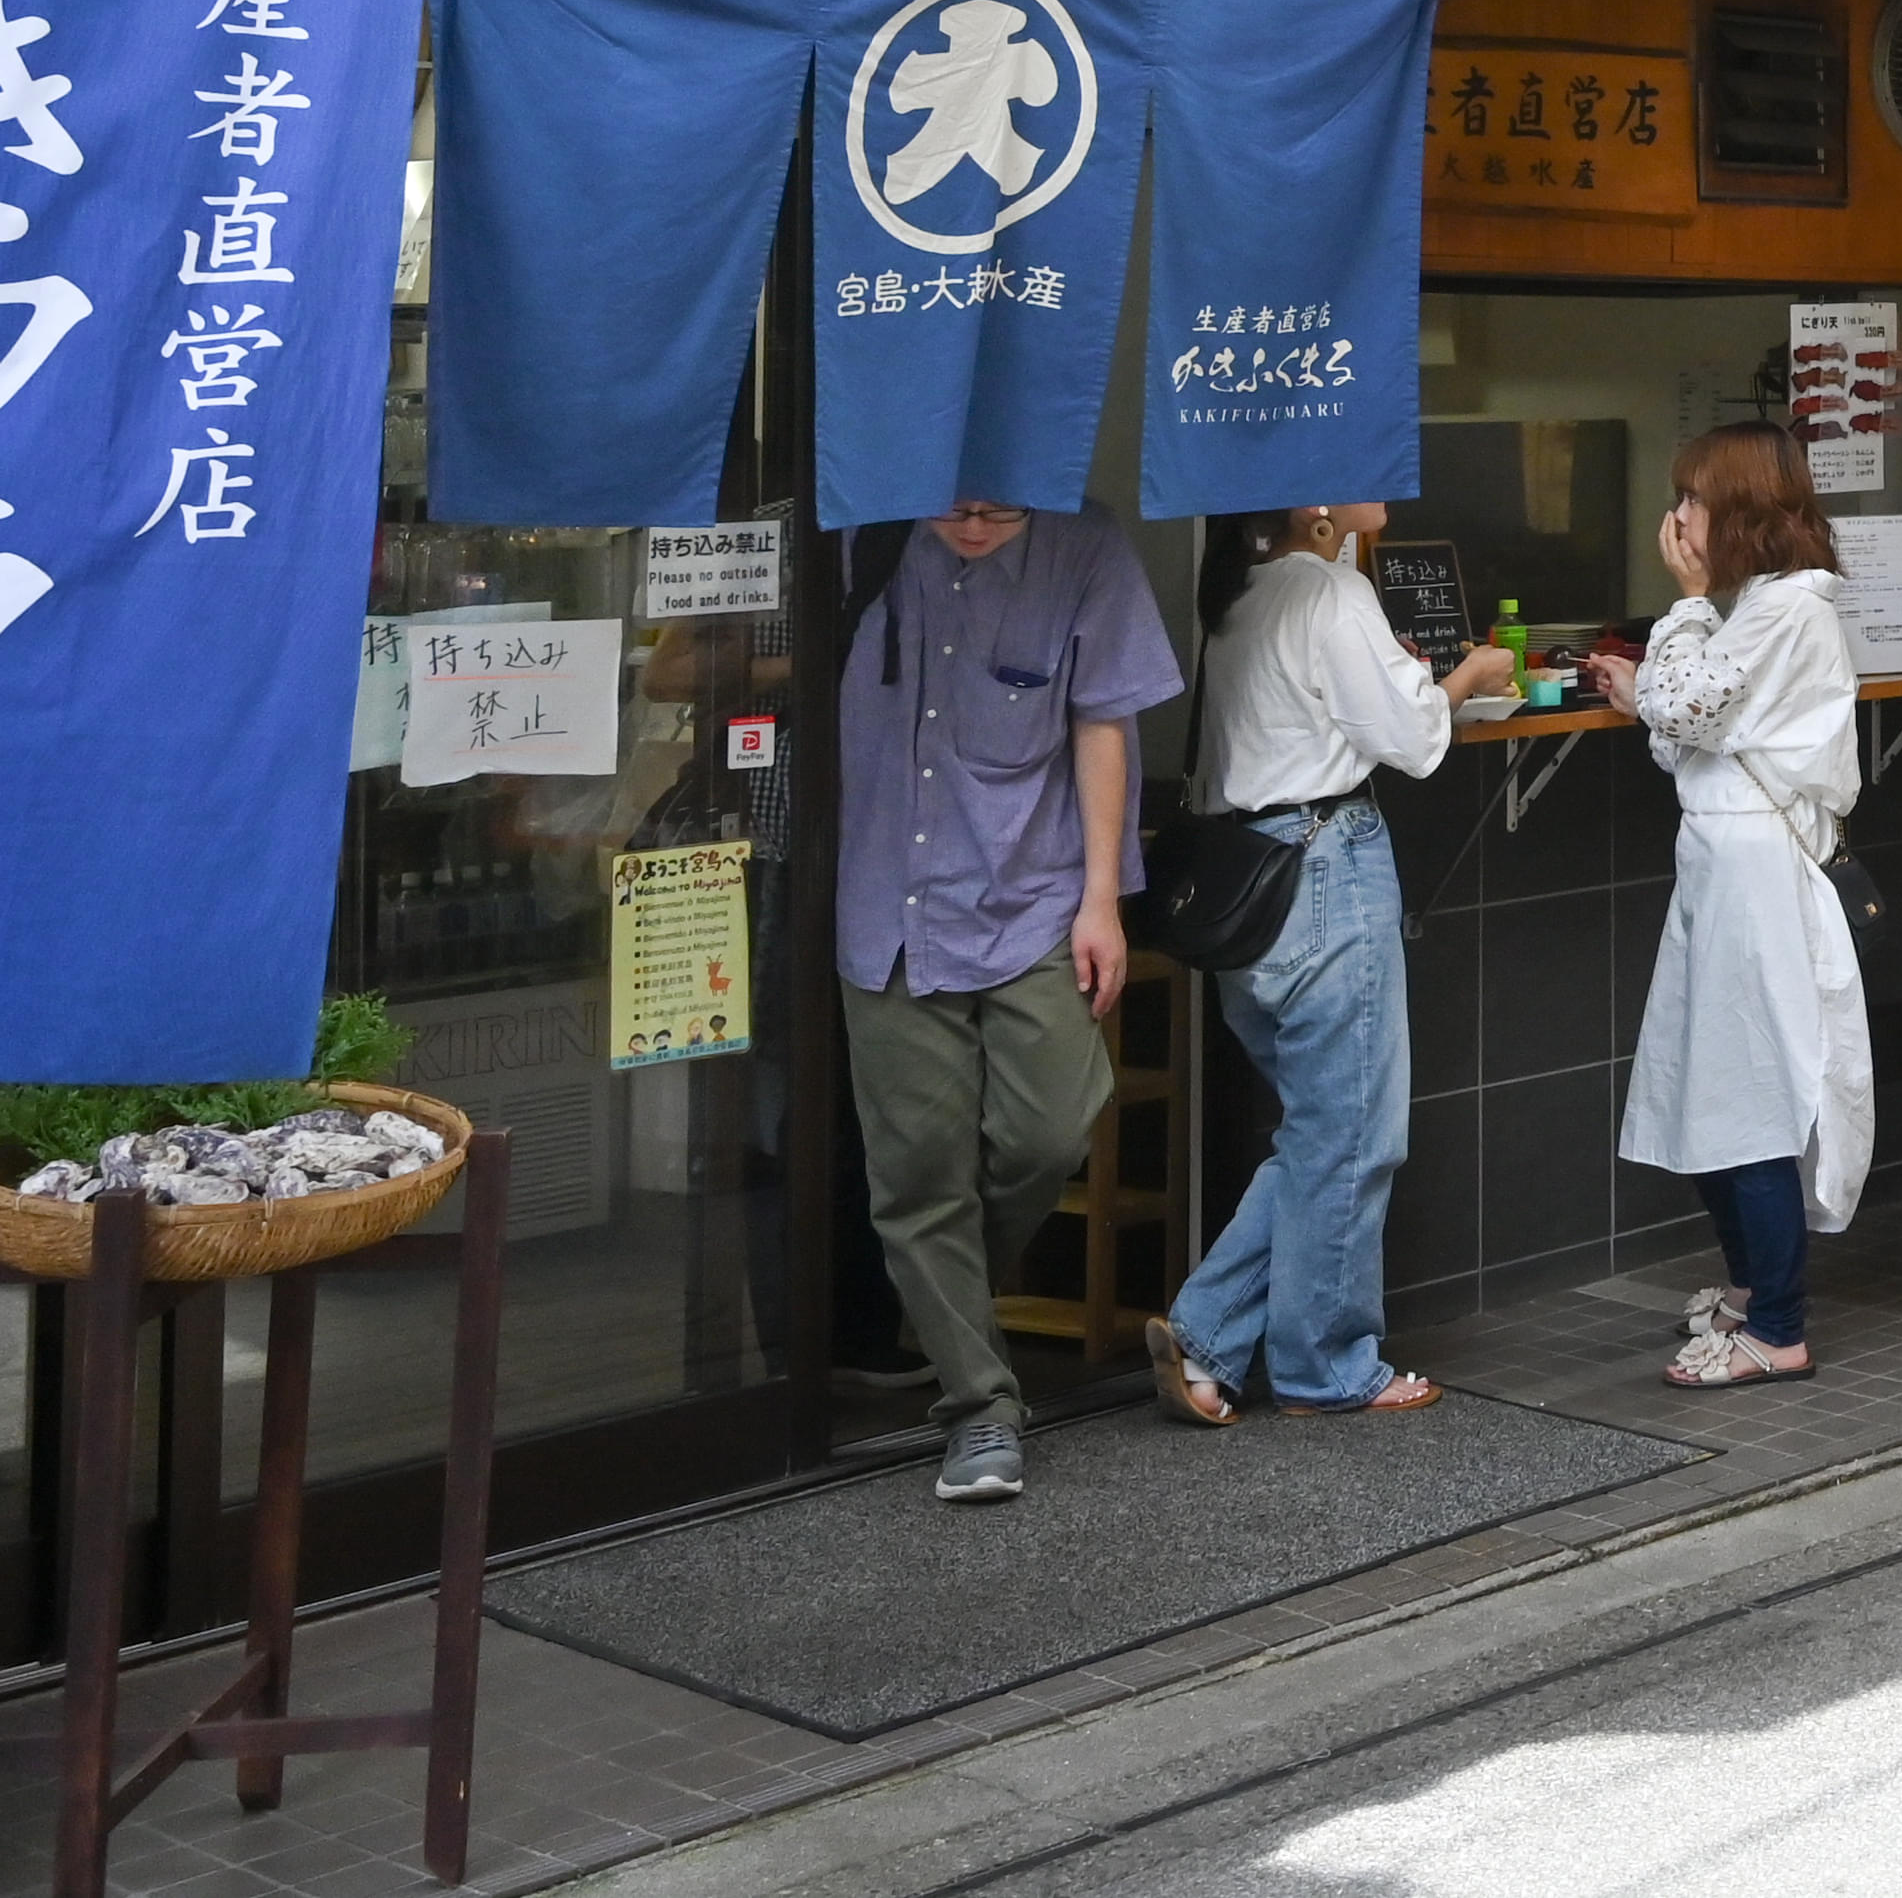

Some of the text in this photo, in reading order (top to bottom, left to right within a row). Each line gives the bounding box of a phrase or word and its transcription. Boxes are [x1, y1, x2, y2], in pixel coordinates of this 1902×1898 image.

[1192, 302, 1332, 334] 生産者直営店
[1801, 315, 1838, 330] にぎり天
[1171, 338, 1356, 393] かきふくまる
[1180, 402, 1344, 424] KAKIFUKUMARU
[650, 531, 776, 559] 持ち込み禁止
[649, 566, 769, 586] Please no outside
[1384, 558, 1448, 583] 持ち込み
[664, 593, 693, 610] food
[699, 592, 722, 607] and
[1415, 588, 1455, 611] 禁止
[426, 634, 568, 676] 持ち込み
[467, 690, 568, 751] 禁止
[736, 751, 765, 763] PayPay
[641, 850, 737, 881] ようこそ宮島へ
[634, 884, 676, 898] Welcome
[693, 876, 742, 892] Miyajima
[398, 1001, 599, 1086] KIRIN
